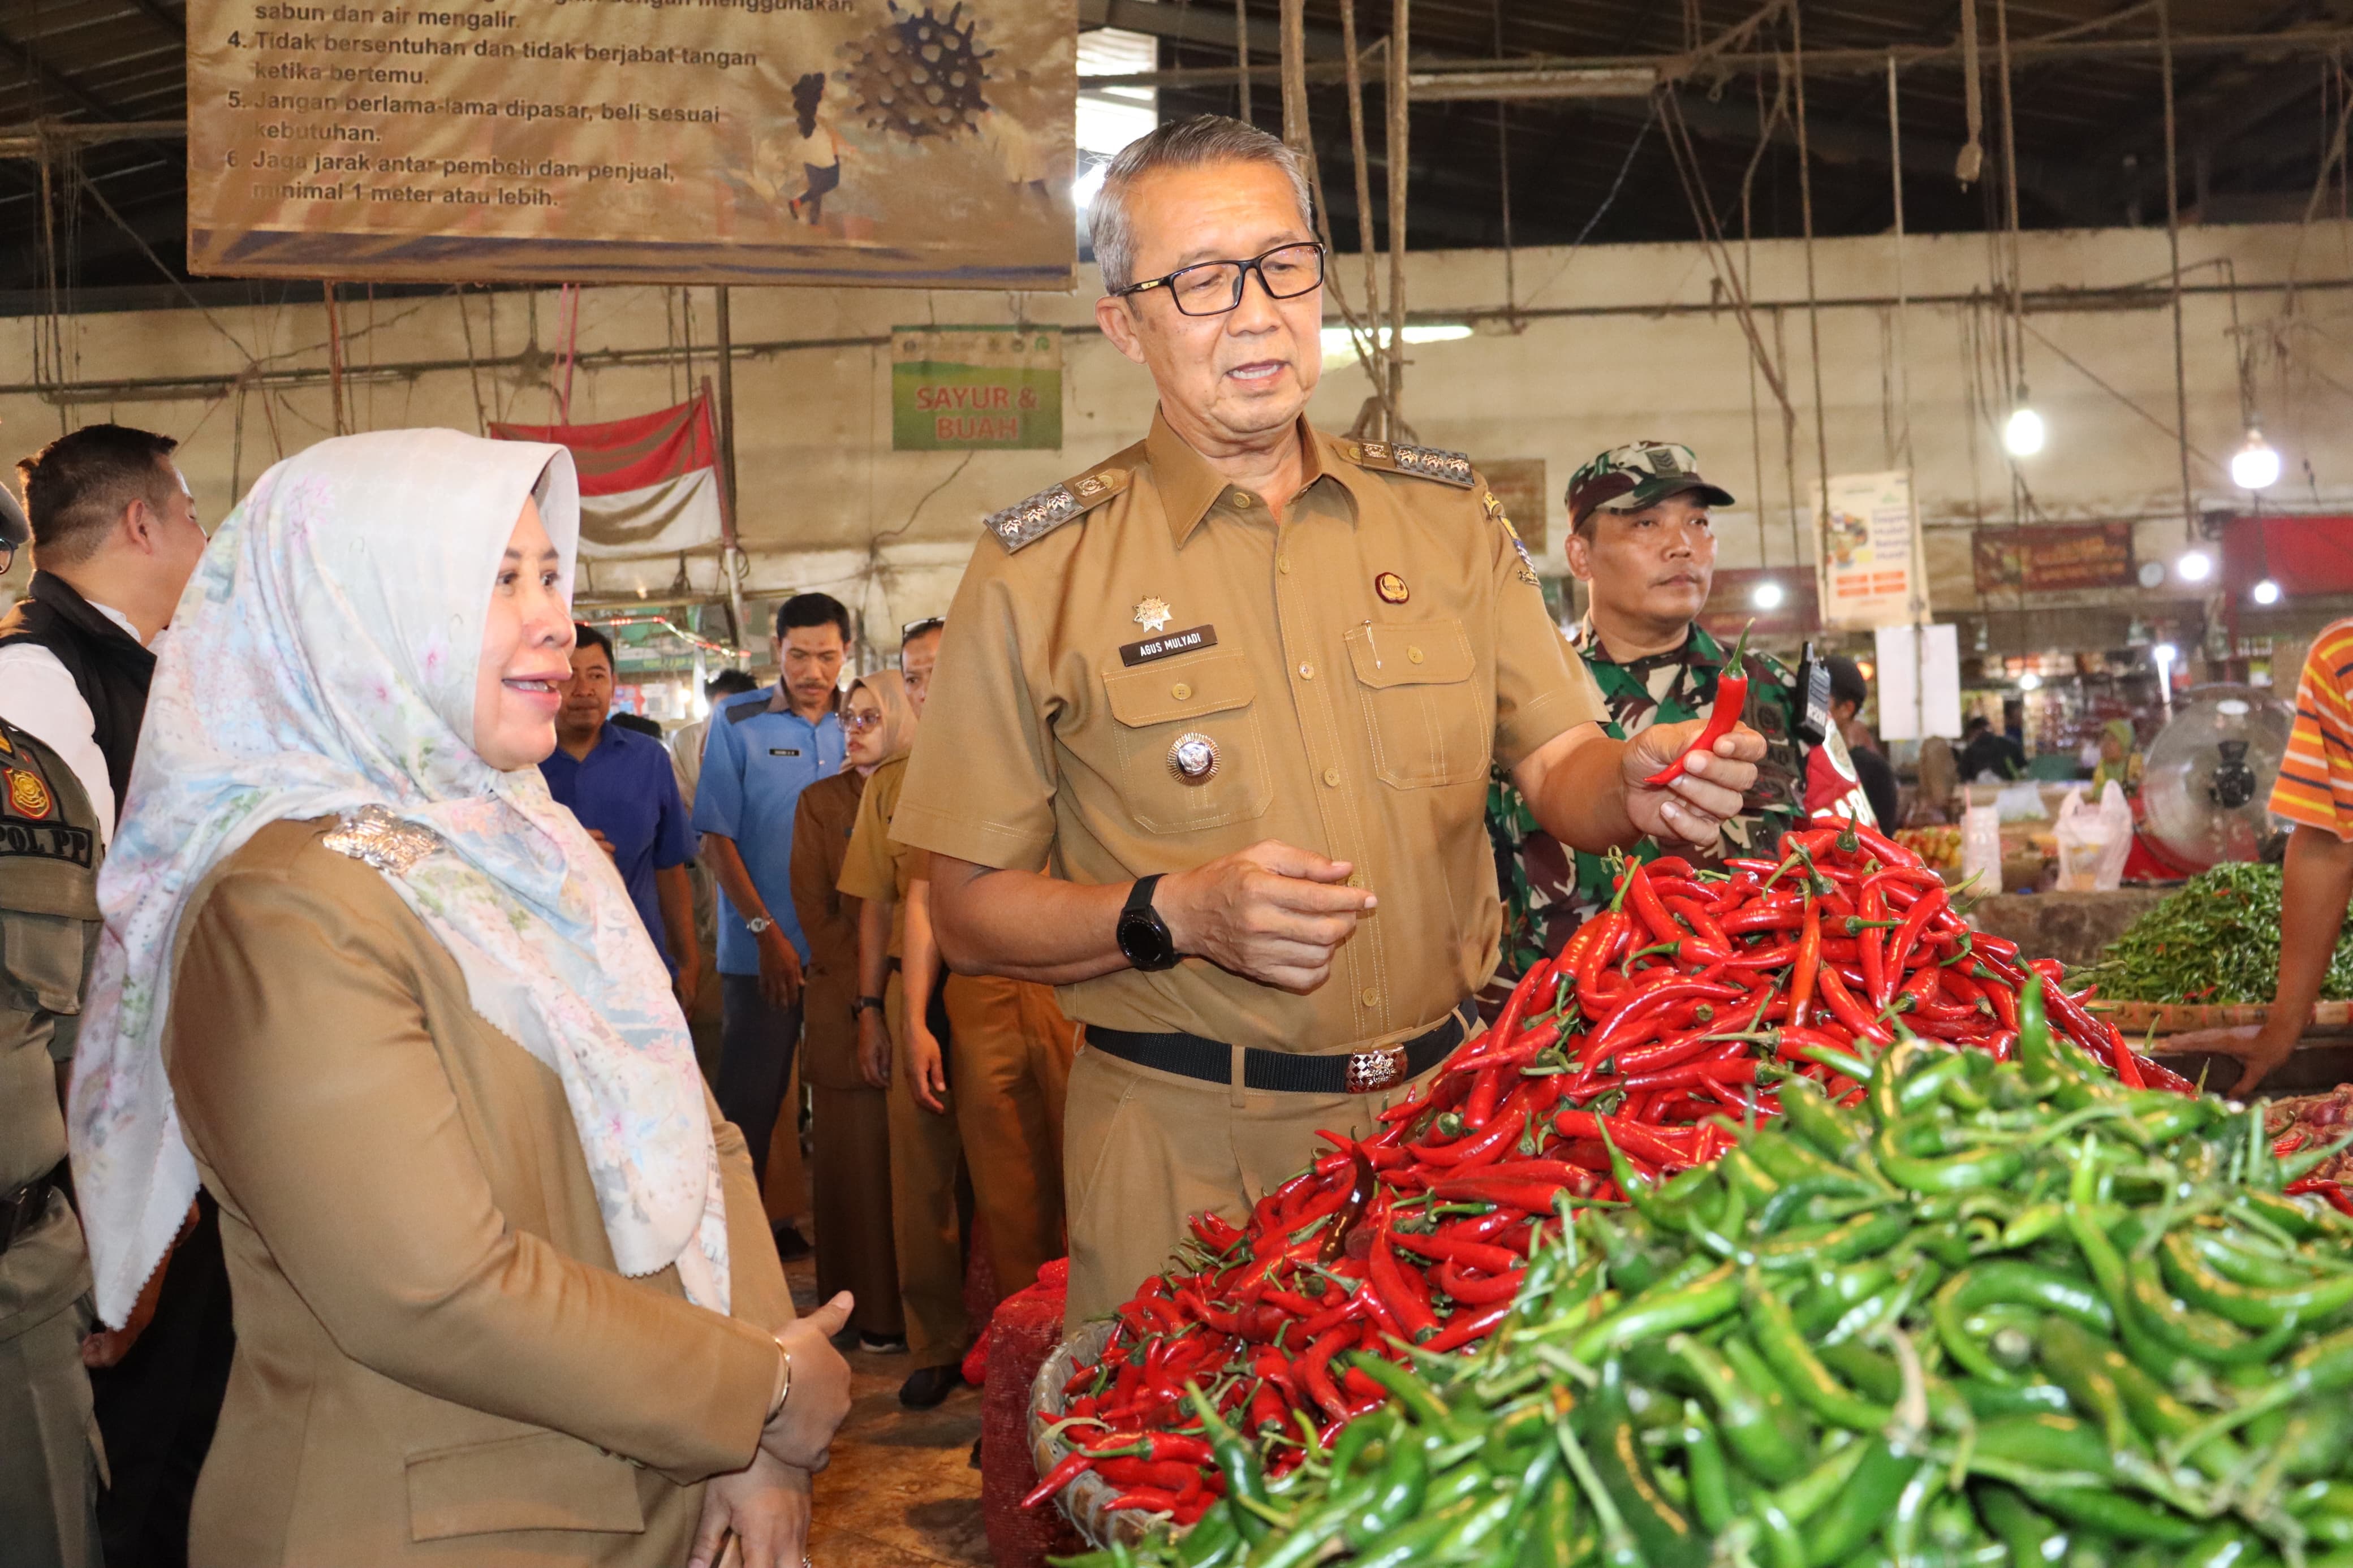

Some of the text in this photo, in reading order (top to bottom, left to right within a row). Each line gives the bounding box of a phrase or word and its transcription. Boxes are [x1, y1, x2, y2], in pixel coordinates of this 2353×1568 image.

[255, 3, 325, 21] sabun
[333, 5, 376, 24] dan
[382, 7, 411, 25] air
[227, 31, 757, 68] 4. Tidak bersentuhan dan tidak berjabat tangan
[255, 63, 429, 85] ketika bertemu.
[228, 91, 720, 123] 5. Jangan berlama-lama dipasar, beli sesuai
[255, 122, 381, 142] kebutuhan.
[253, 150, 307, 170] Jaga
[314, 152, 370, 174] jarak
[378, 155, 435, 172] antar
[443, 158, 531, 179] pembeli
[539, 161, 579, 177] dan
[587, 163, 674, 184] penjual,
[253, 182, 558, 207] minimal 1 meter atau lebih.
[916, 387, 1037, 409] SAYUR &
[936, 417, 1019, 440] BUAH
[1140, 633, 1201, 656] AGUS MULYADI
